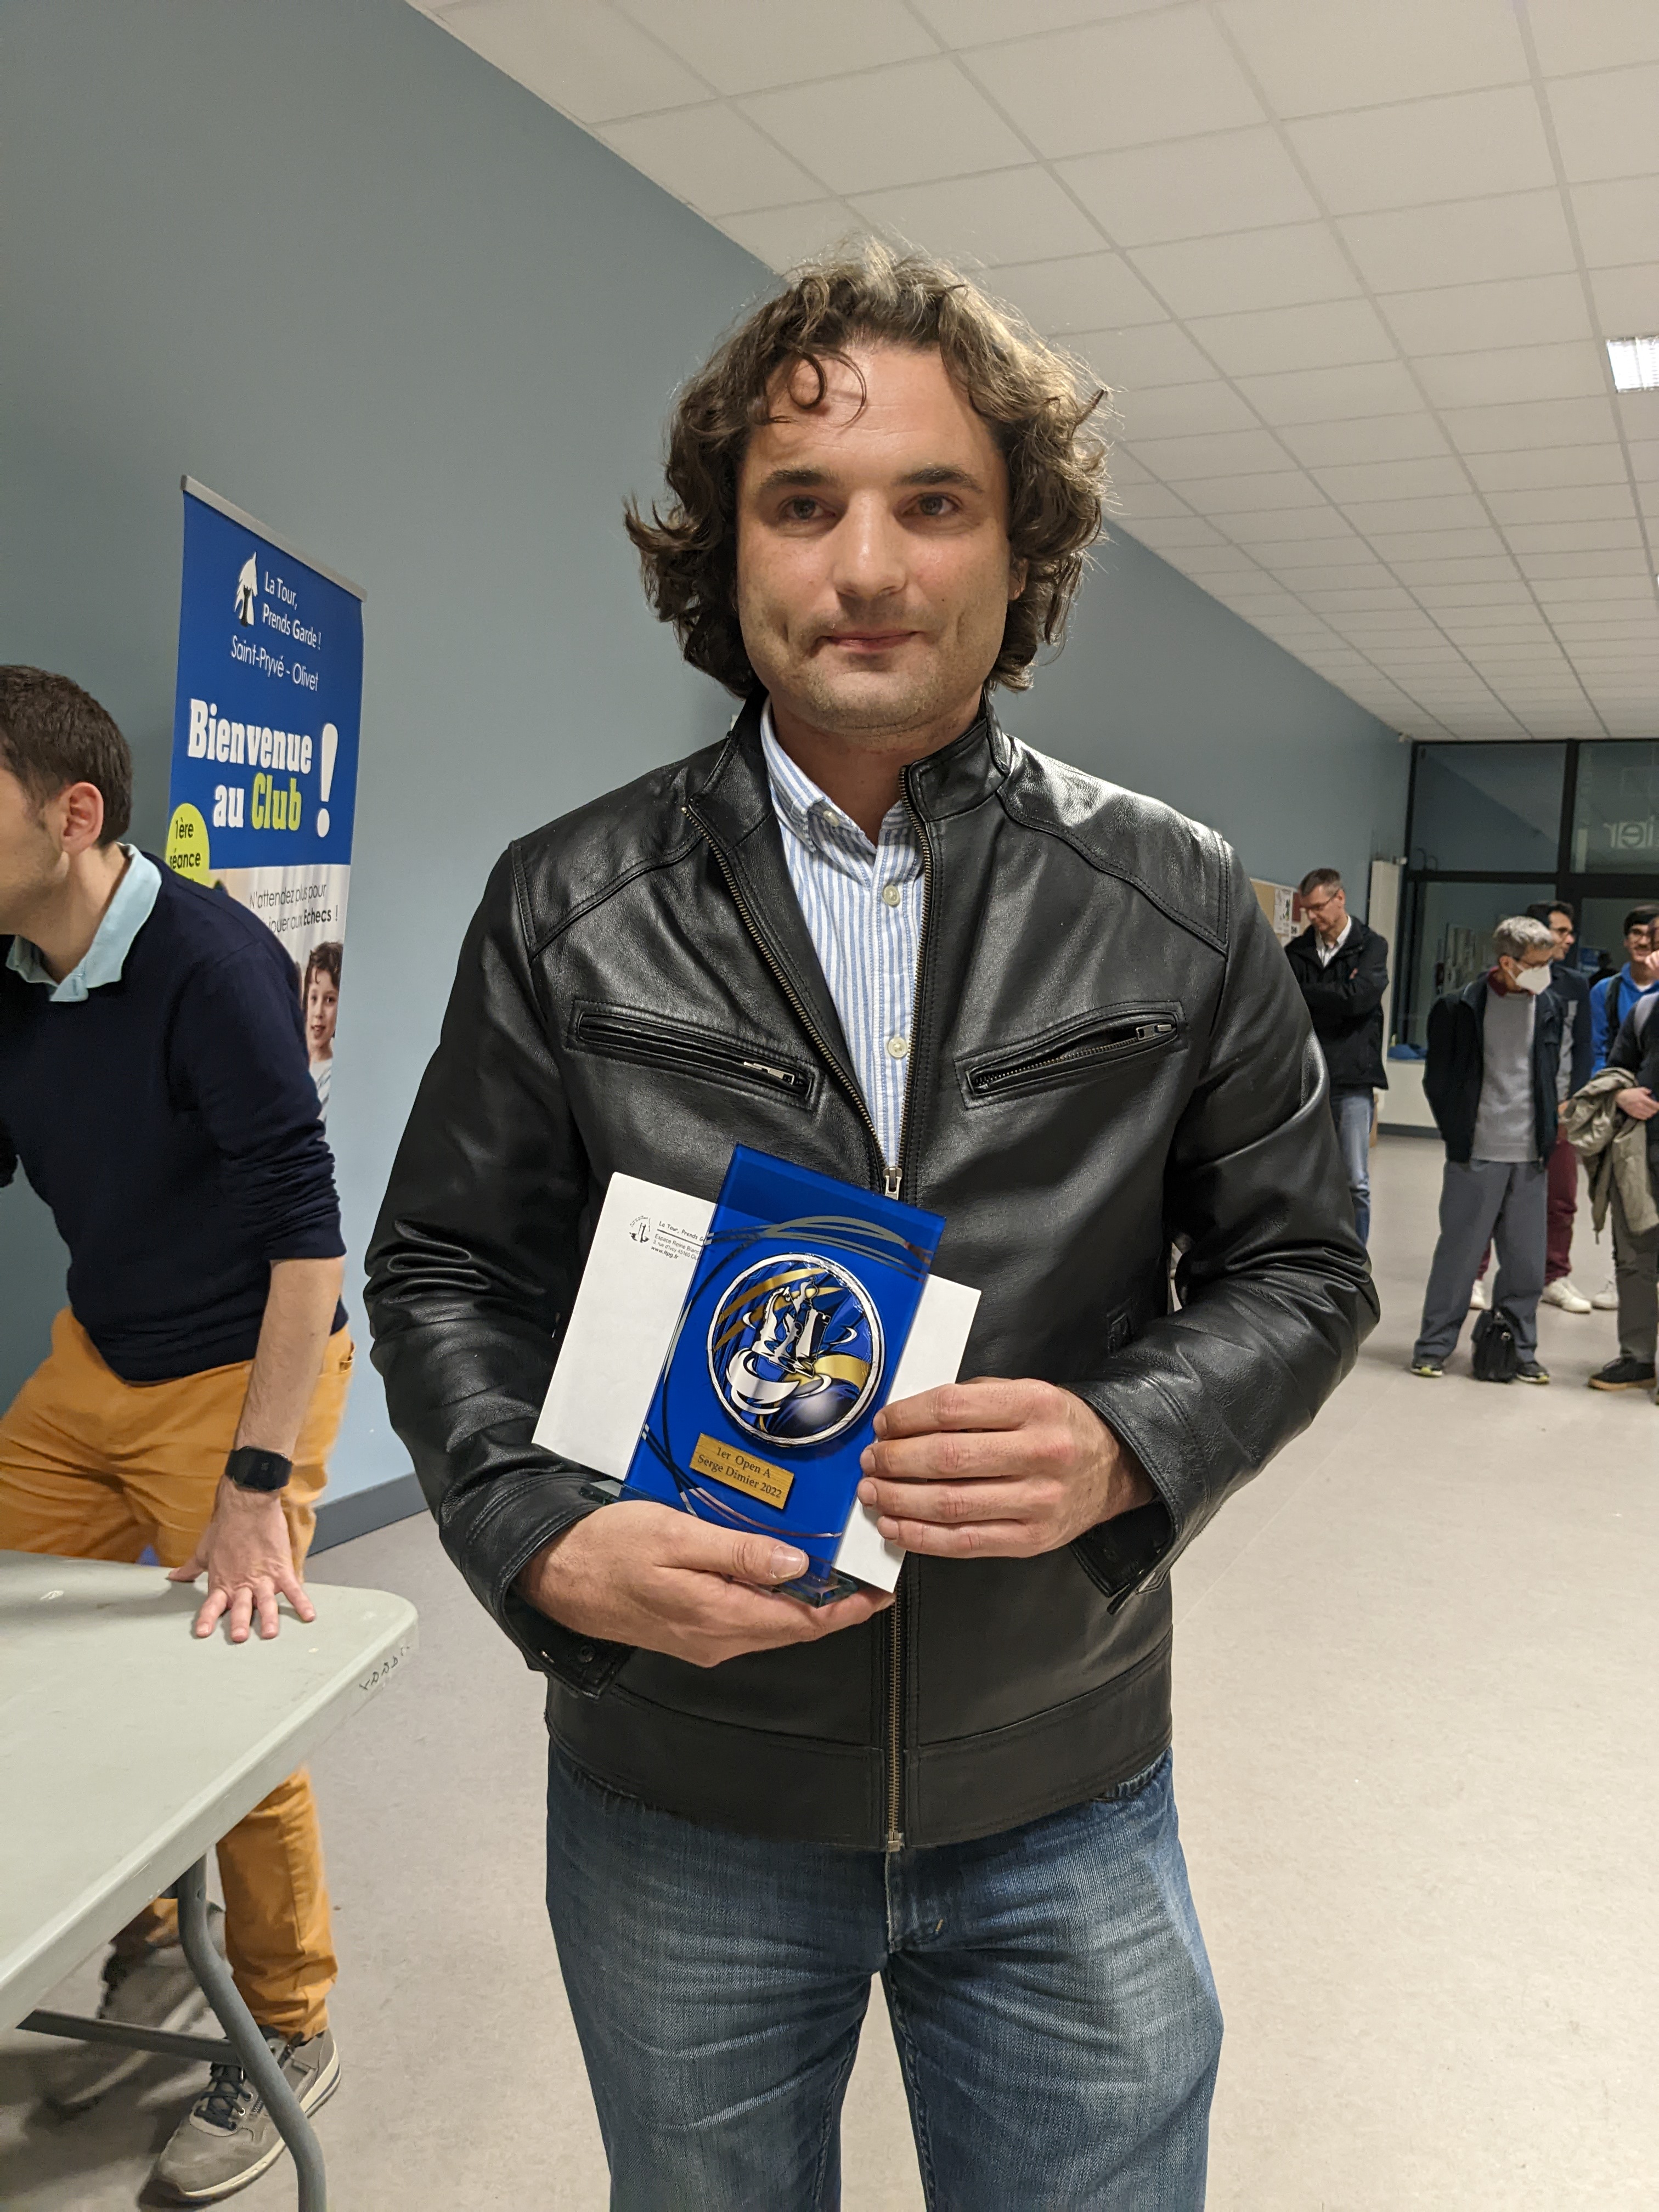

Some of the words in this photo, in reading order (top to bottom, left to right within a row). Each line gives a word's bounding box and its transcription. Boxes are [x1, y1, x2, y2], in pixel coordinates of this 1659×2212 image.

[264, 571, 275, 595] La
[277, 577, 297, 611] Tour,
[262, 603, 291, 636] Prends
[292, 619, 317, 648] Garde
[230, 635, 284, 678] Saint-Pryvé
[293, 662, 319, 692] Olivet
[188, 698, 313, 775] Bienvenue
[213, 784, 245, 828] au
[252, 772, 302, 832] Club
[175, 817, 194, 839] 1ère
[249, 887, 294, 910] N'attendez
[295, 884, 307, 906] plus
[308, 884, 327, 904] pour
[303, 907, 332, 926] Echecs
[655, 1234, 672, 1244] Espace
[672, 1240, 685, 1249] Reine
[681, 1229, 698, 1239] Prends
[697, 1454, 724, 1473] Serge
[726, 1466, 759, 1488] Dimier
[760, 1482, 782, 1499] 2022
[716, 1447, 731, 1460] 1er
[735, 1455, 761, 1474] Open
[763, 1468, 771, 1479] A
